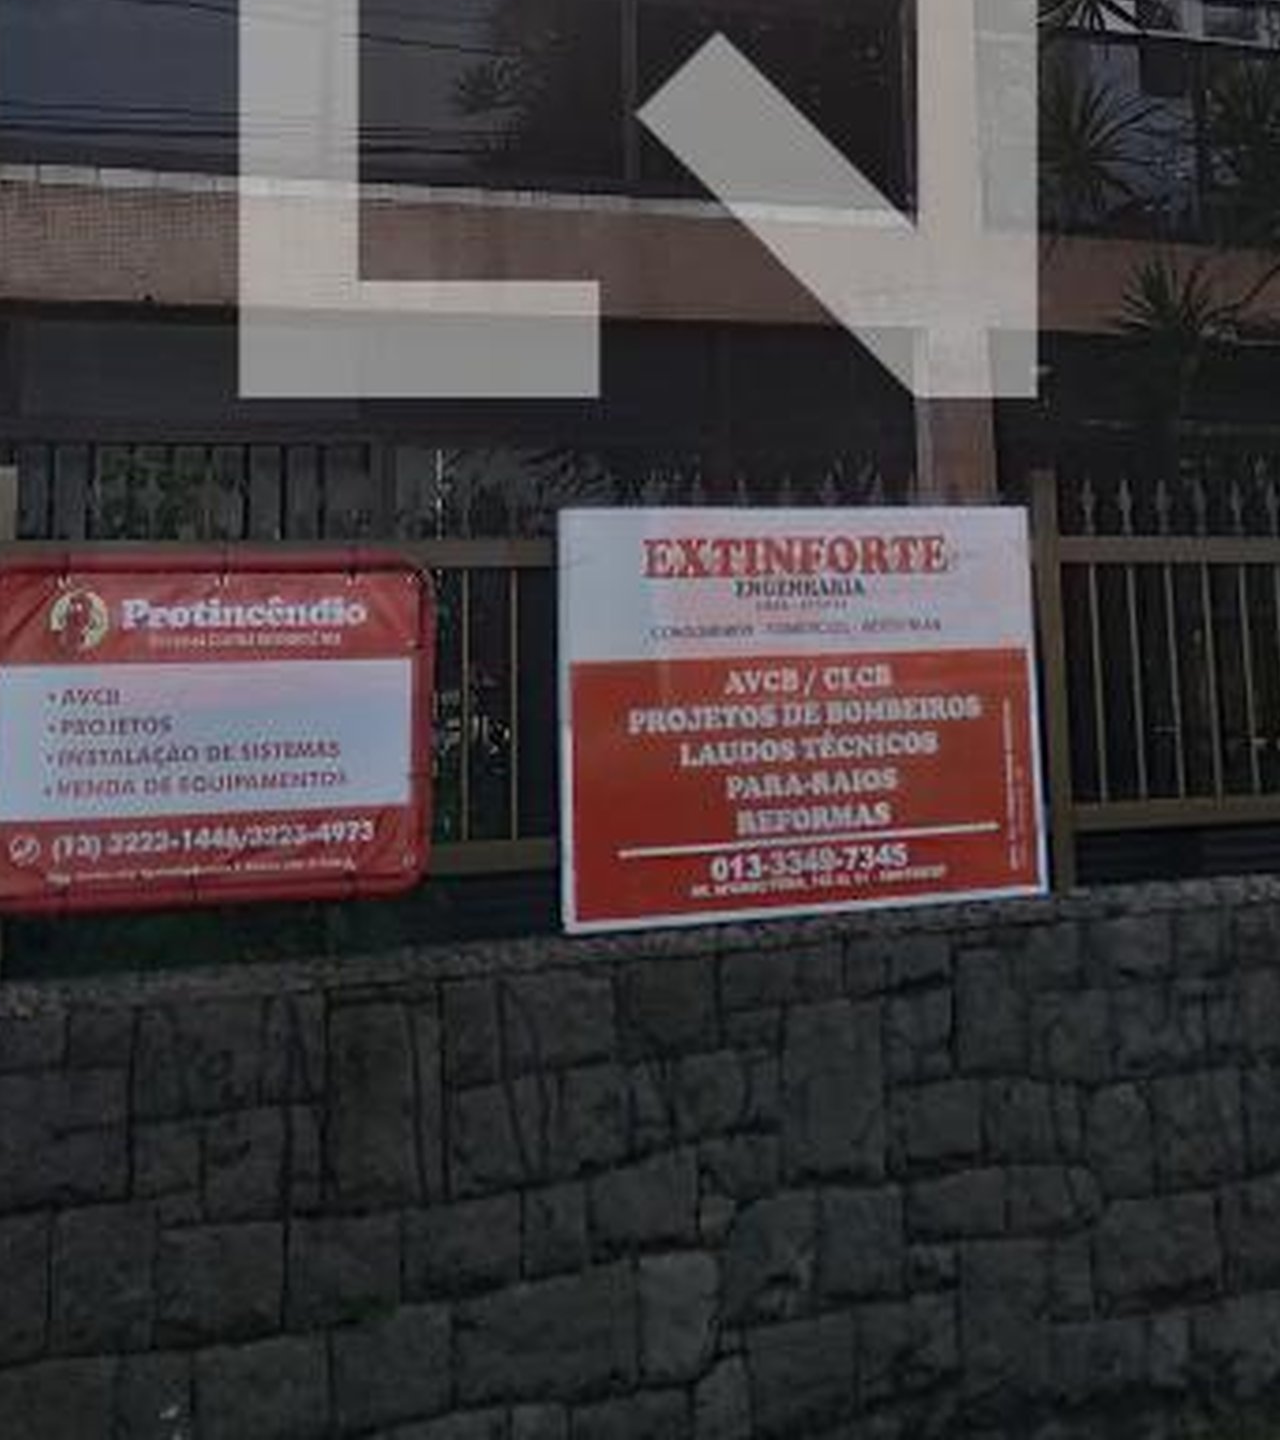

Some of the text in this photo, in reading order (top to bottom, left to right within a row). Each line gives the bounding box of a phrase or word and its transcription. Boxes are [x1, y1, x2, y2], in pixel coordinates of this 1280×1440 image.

[642, 534, 949, 578] EXTINFORTE
[734, 578, 866, 597] ENGENHARIA
[121, 595, 368, 630] Protincêndio
[724, 670, 799, 695] AVCB
[822, 665, 893, 690] CLCB
[60, 715, 174, 737] PROJETOS
[628, 694, 983, 735] PROJETOS DE BOMBEIROS
[58, 740, 342, 768] INSTALAÇÃO DE SISTEMAS
[679, 729, 939, 767] LAUDOS TÉCNICOS
[57, 770, 348, 798] VENDA DE EQUIPAMENTOS
[725, 767, 899, 800] PARA-RAIOS
[736, 801, 892, 836] REFORMAS
[52, 834, 101, 860] (13)
